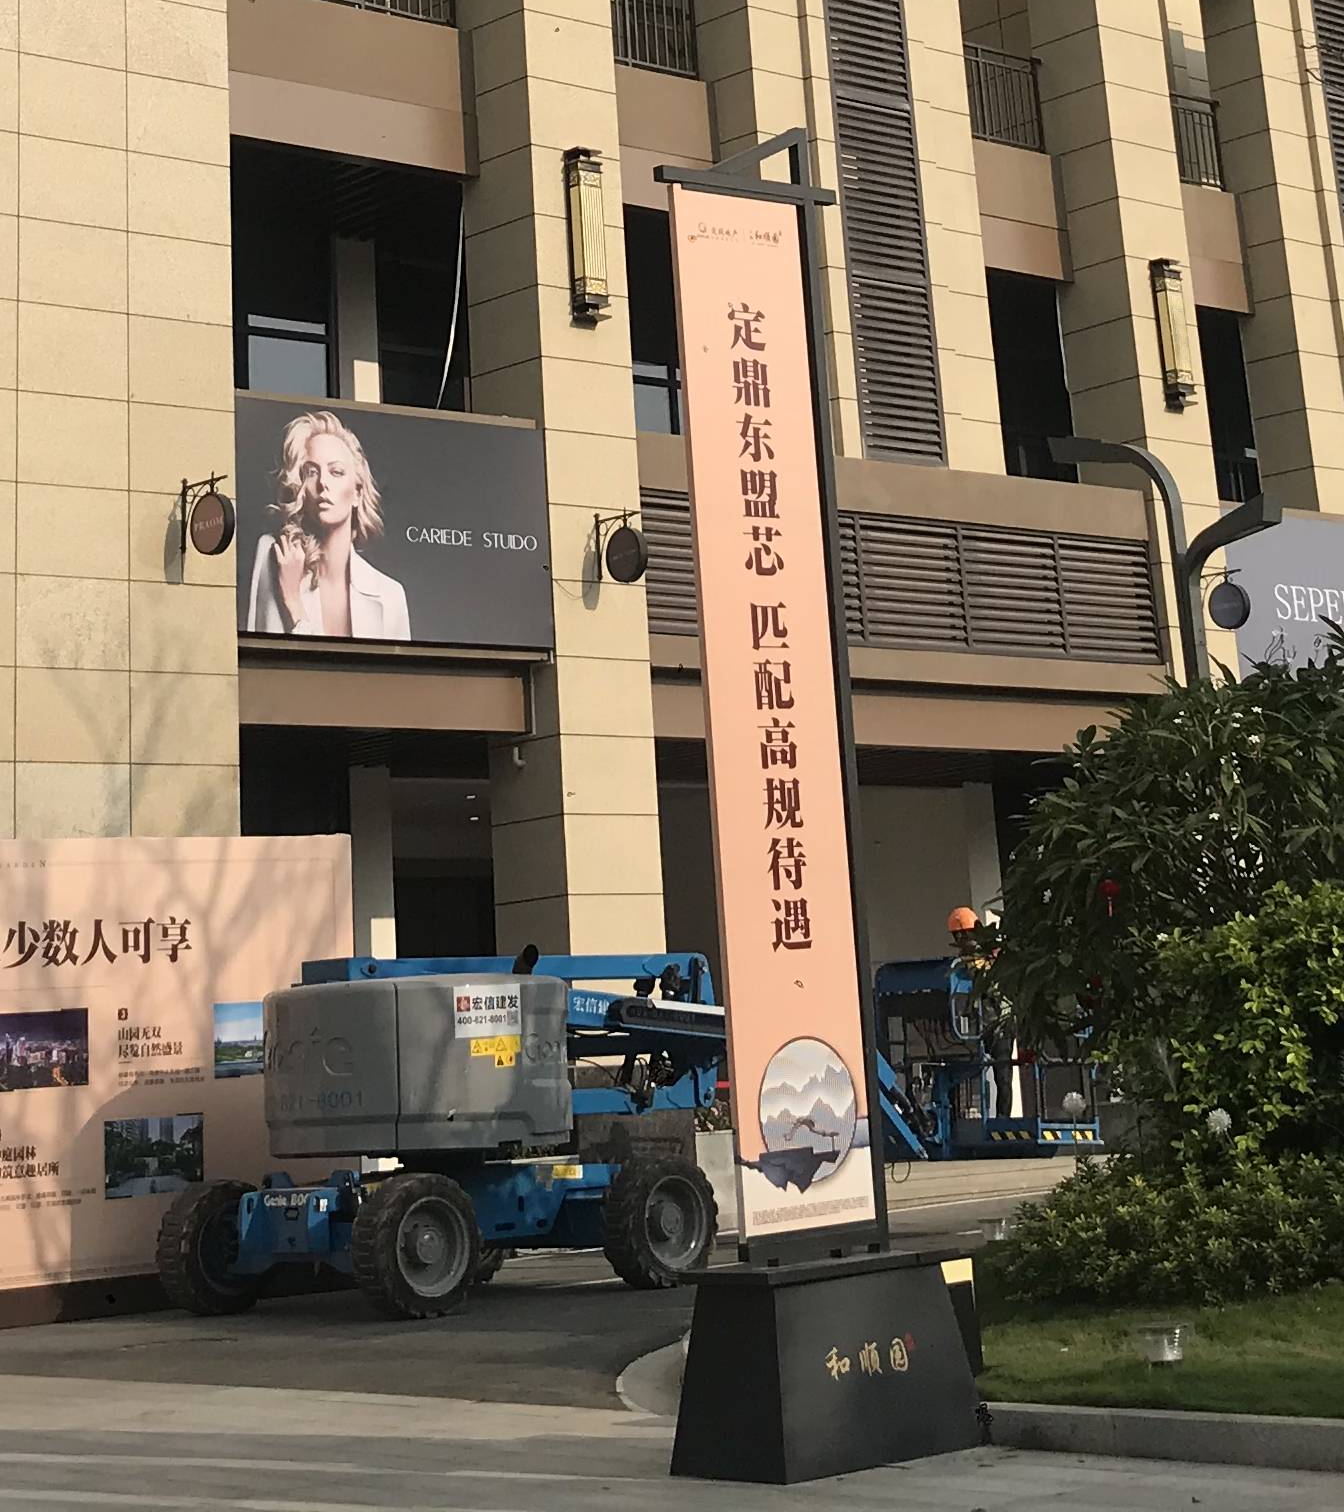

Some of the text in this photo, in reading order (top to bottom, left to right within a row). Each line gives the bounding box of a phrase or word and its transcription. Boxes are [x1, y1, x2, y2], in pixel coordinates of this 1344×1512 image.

[727, 302, 785, 577] 定鼎东盟芯
[750, 601, 813, 953] 匹配高规待遇
[472, 995, 519, 1011] 宏信建发
